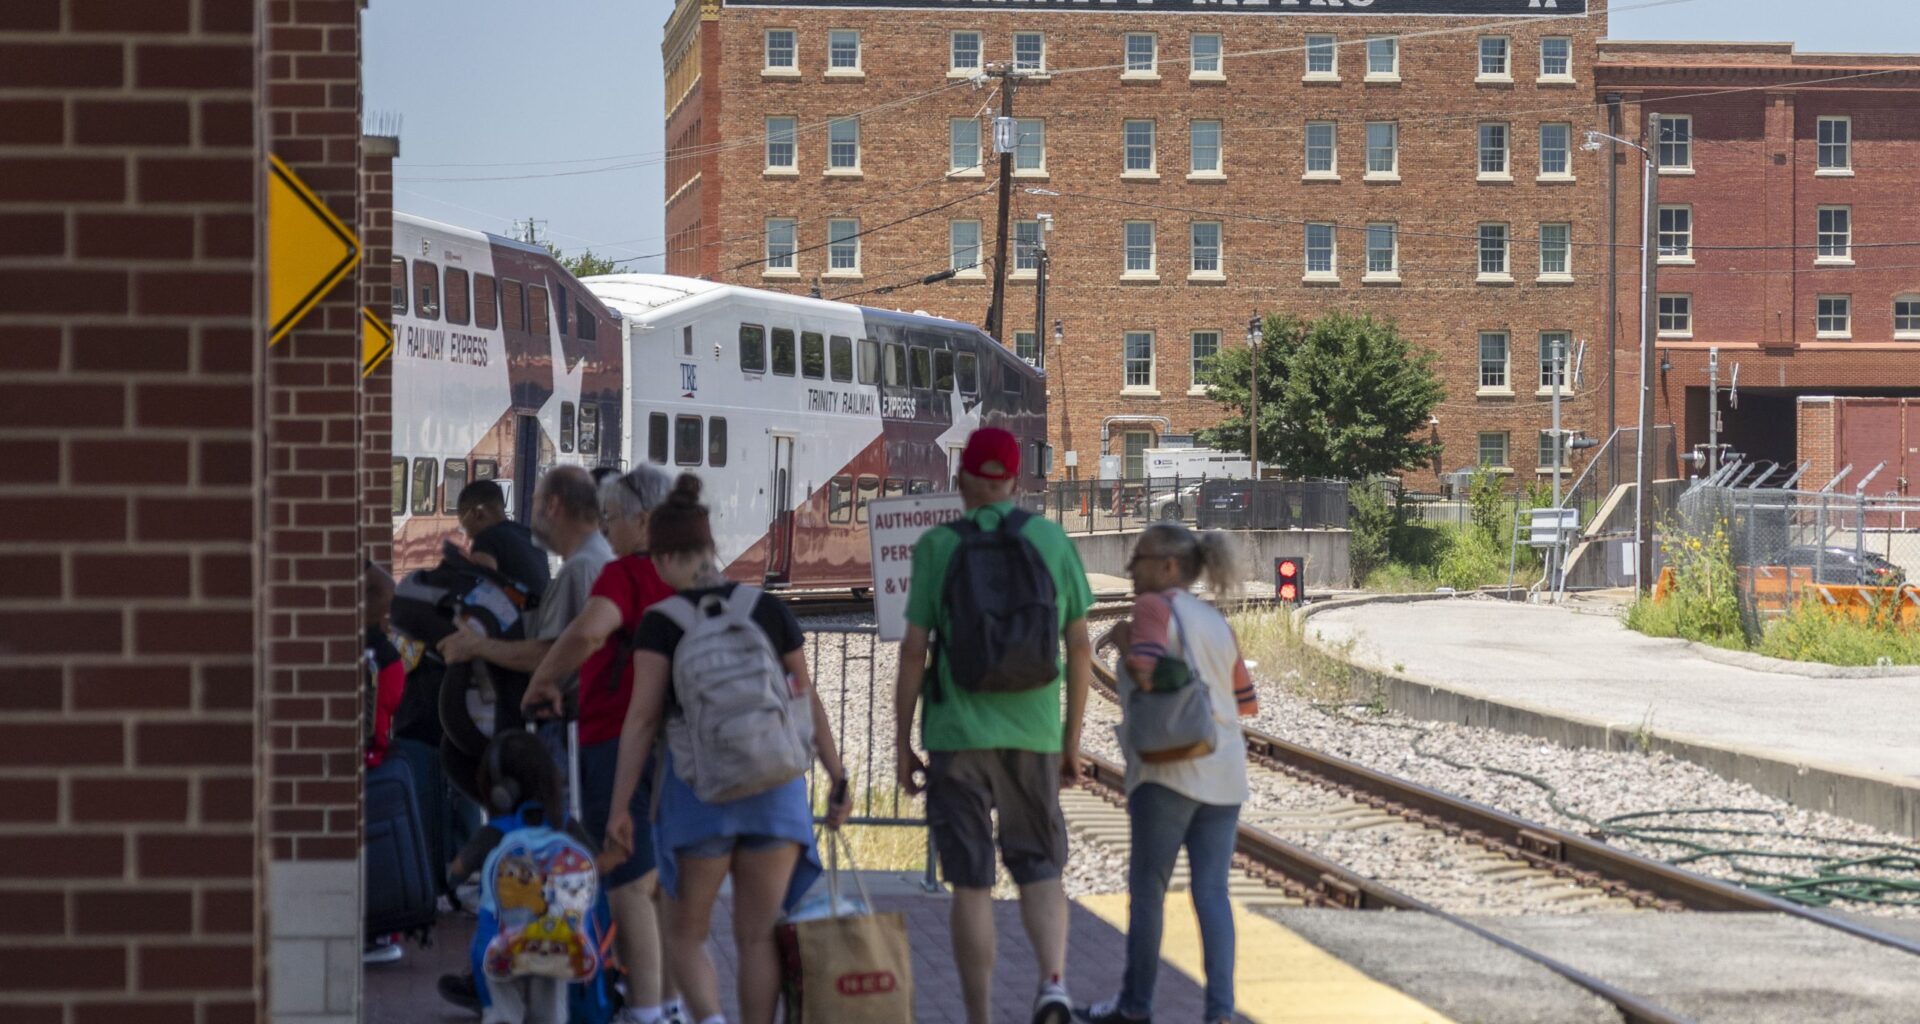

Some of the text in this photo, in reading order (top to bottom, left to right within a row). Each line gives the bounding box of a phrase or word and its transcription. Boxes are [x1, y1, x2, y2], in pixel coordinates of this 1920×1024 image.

[407, 327, 445, 360] RAILWAY
[451, 333, 488, 367] EXPRESS
[680, 363, 697, 391] TRE
[808, 388, 916, 419] TRINITY RAILWAY EXPRESS
[875, 509, 960, 529] AUTHORIZED
[885, 578, 896, 594] &
